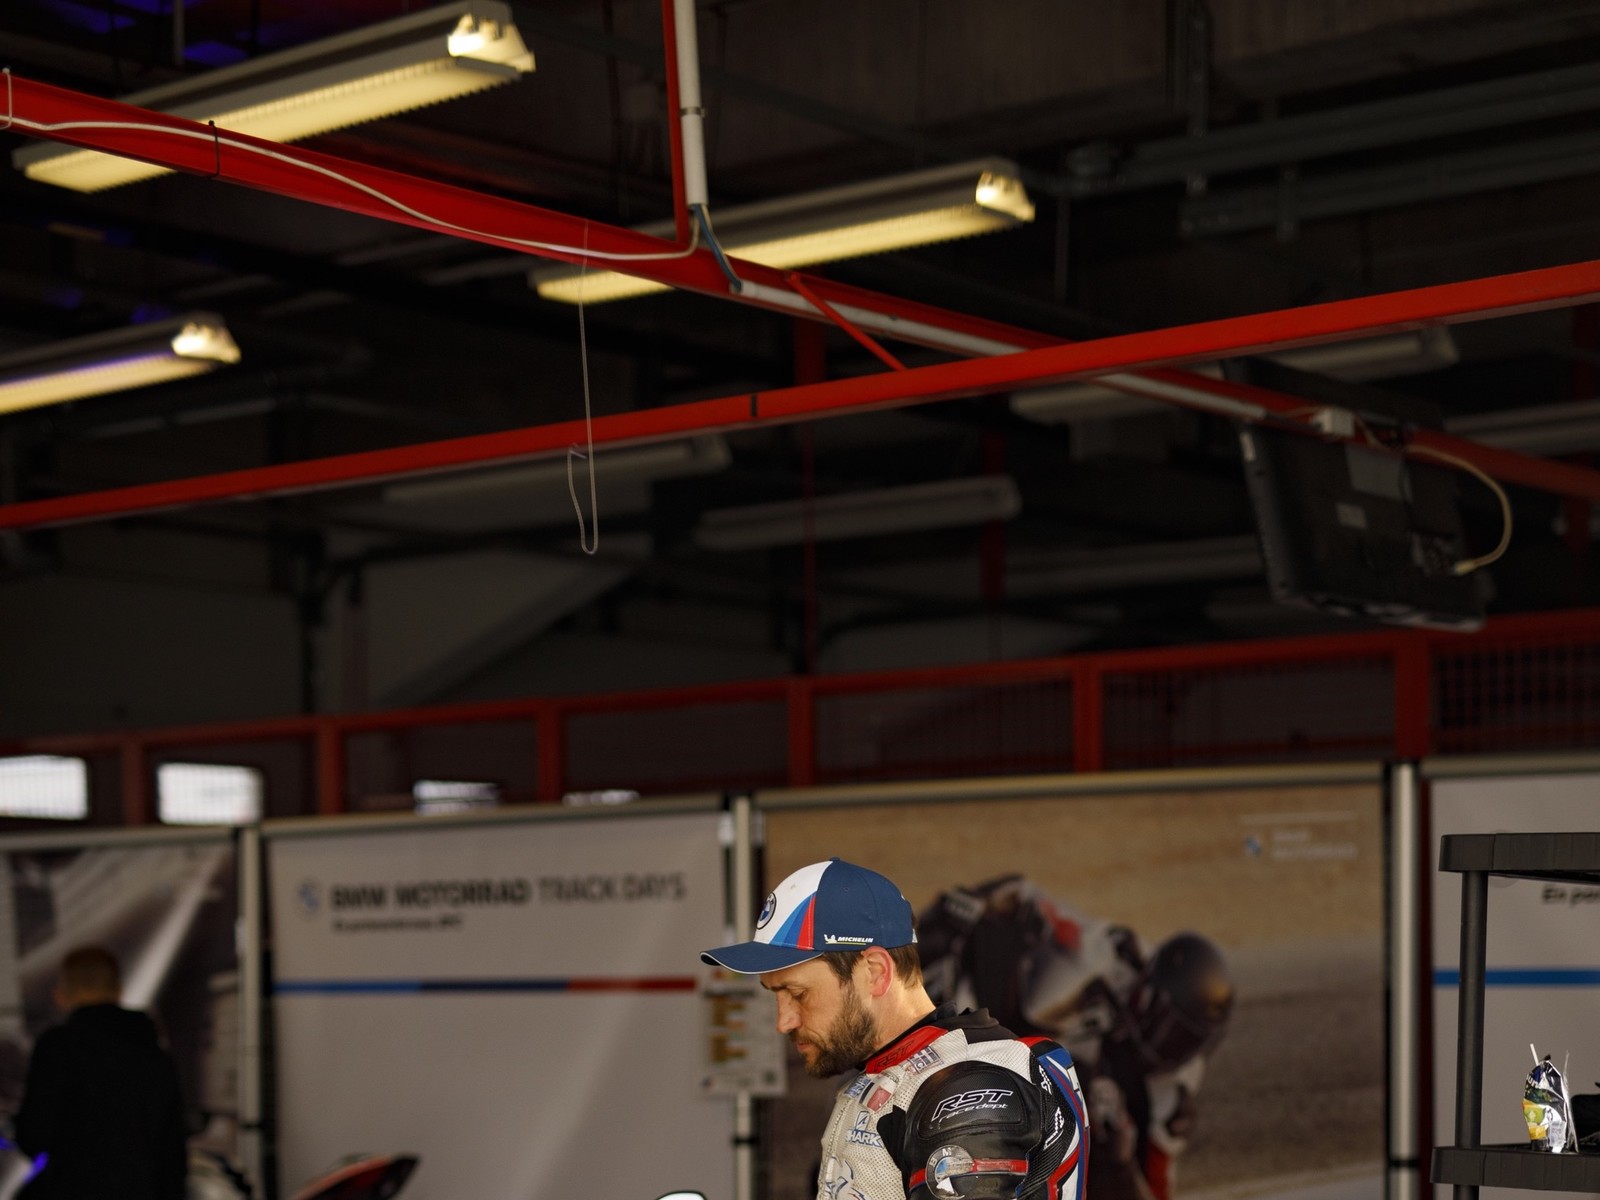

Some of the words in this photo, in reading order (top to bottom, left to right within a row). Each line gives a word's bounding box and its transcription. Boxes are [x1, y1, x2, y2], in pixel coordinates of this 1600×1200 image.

[331, 885, 386, 912] BMW
[394, 877, 532, 909] MOTORRAD
[538, 875, 615, 903] TRACK
[623, 872, 687, 901] DAYS
[931, 1088, 1014, 1123] RST
[938, 1107, 975, 1124] race
